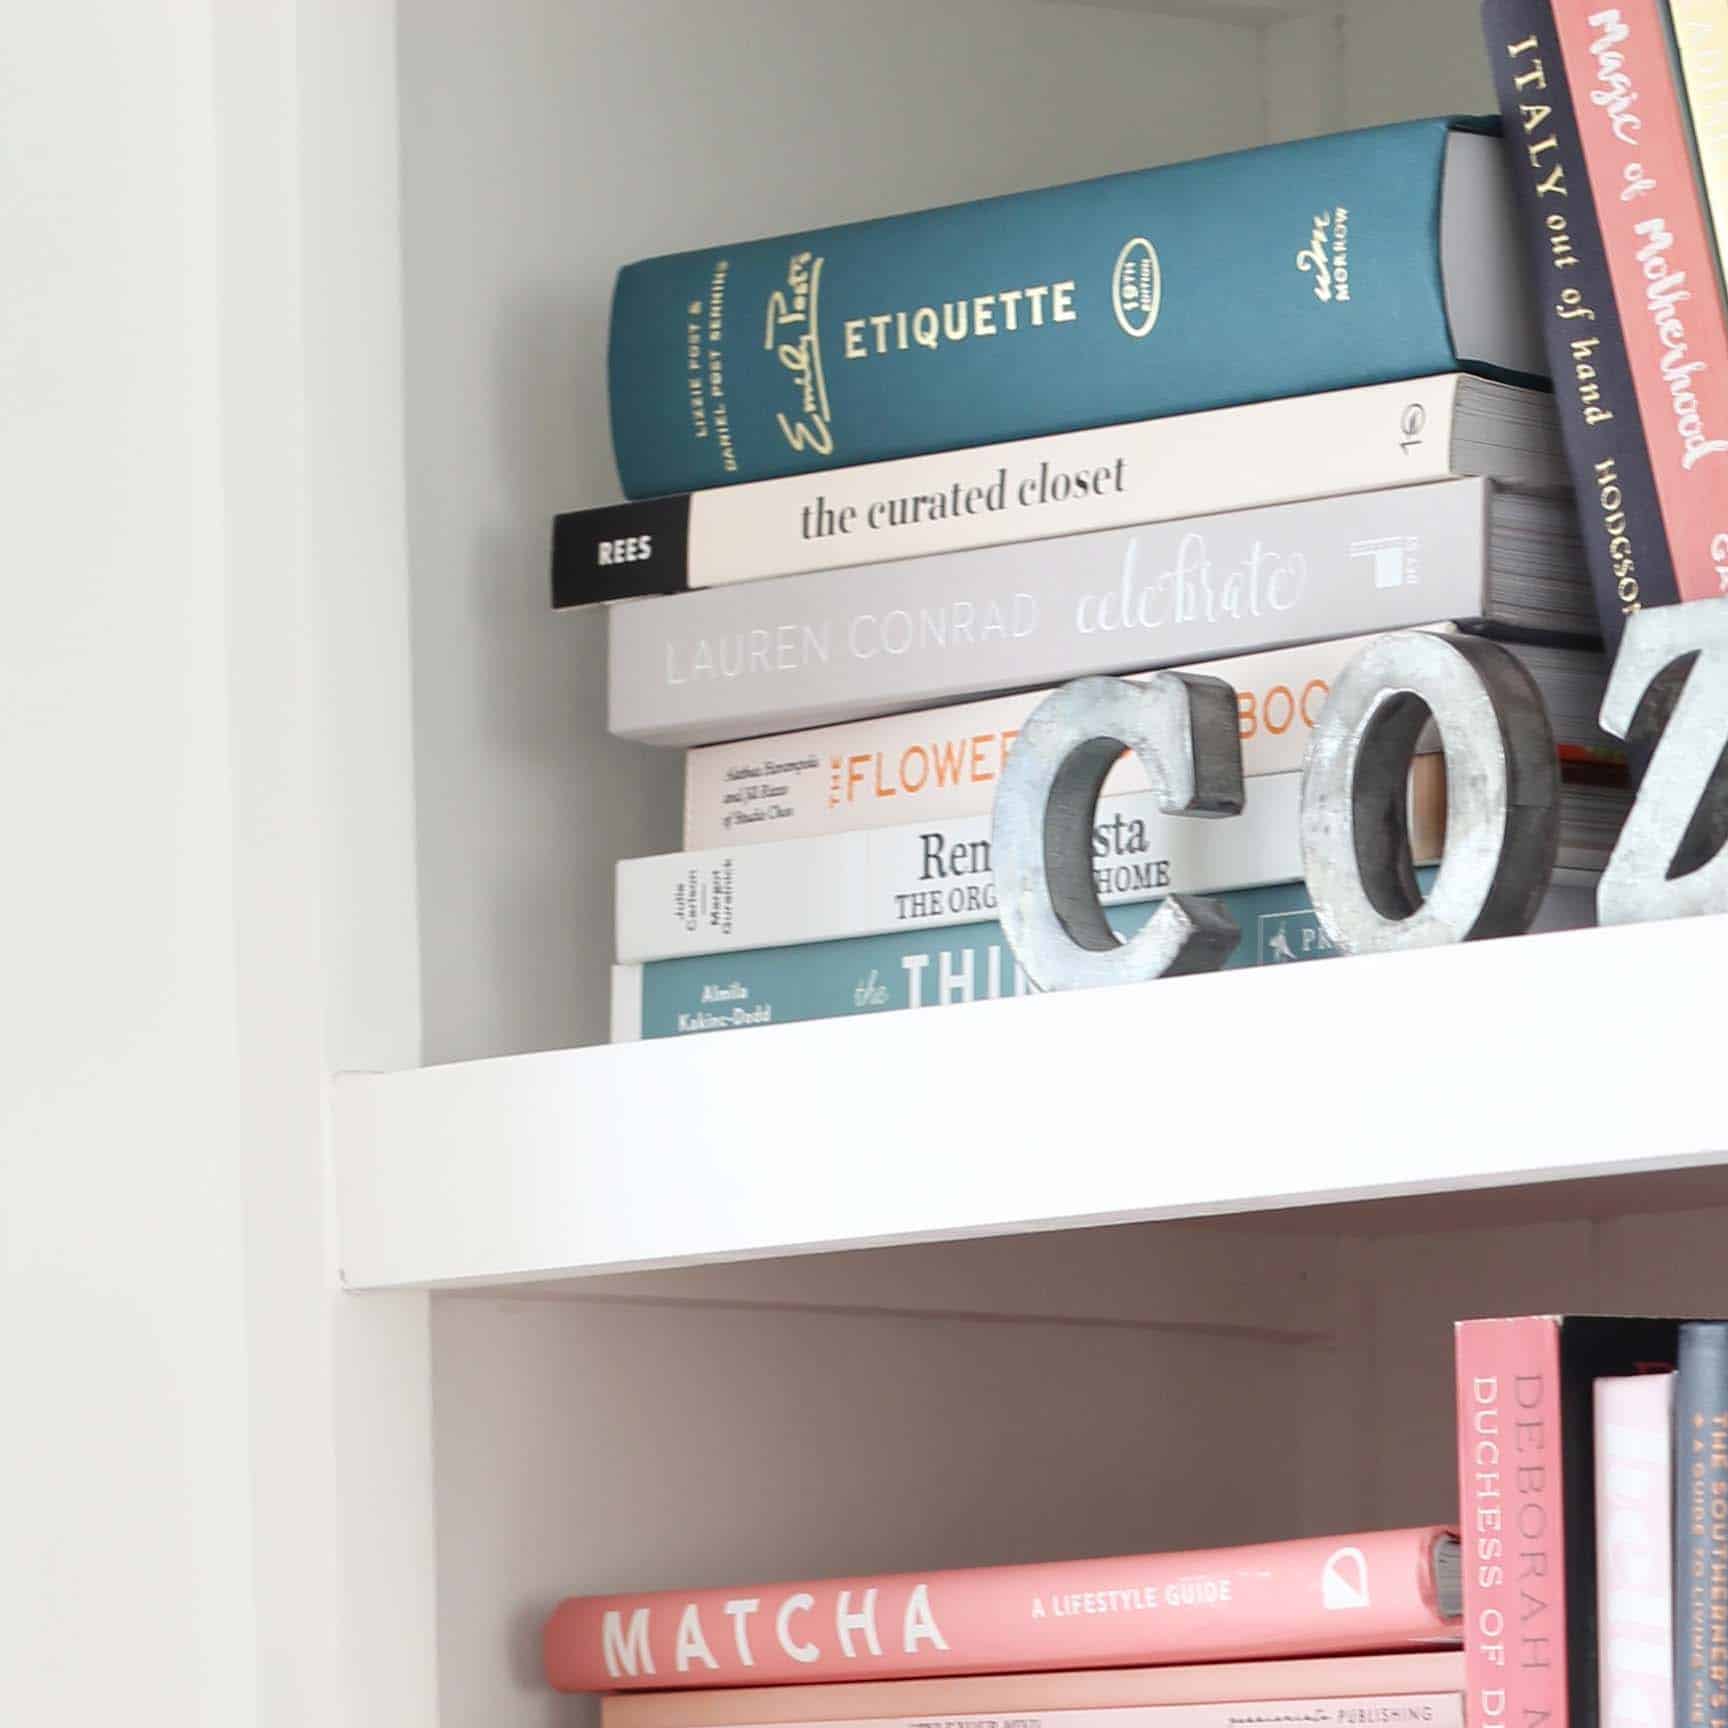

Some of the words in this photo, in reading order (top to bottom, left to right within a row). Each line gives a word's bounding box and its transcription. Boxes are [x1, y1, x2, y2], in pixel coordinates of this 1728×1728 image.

[1508, 35, 1567, 197] ITALY
[1588, 9, 1641, 145] Magic
[1621, 162, 1657, 202] of
[1334, 207, 1350, 300] MORROW
[1546, 214, 1580, 269] out
[844, 281, 1077, 359] ETIQUETTE
[1557, 287, 1596, 320] of
[1571, 337, 1612, 426] hand
[801, 495, 857, 541] the
[868, 468, 1007, 530] curated
[1018, 458, 1128, 508] closet
[598, 536, 652, 566] REES
[665, 622, 831, 685] LAUREN
[848, 592, 1040, 659] CONRAD
[895, 889, 943, 920] THE
[1709, 1413, 1728, 1469] THE
[1474, 1377, 1503, 1590] DUCHESS
[1514, 1373, 1552, 1672] DEBORAH
[602, 1583, 951, 1678] MATCHA
[1032, 1596, 1045, 1618] A
[1053, 1586, 1158, 1617] LIFESTYLE
[1165, 1580, 1231, 1606] GUIDE
[1479, 1607, 1505, 1665] OF
[1709, 1480, 1728, 1709] SOUTHERNER'S
[1336, 1705, 1432, 1723] PUBLISHING
